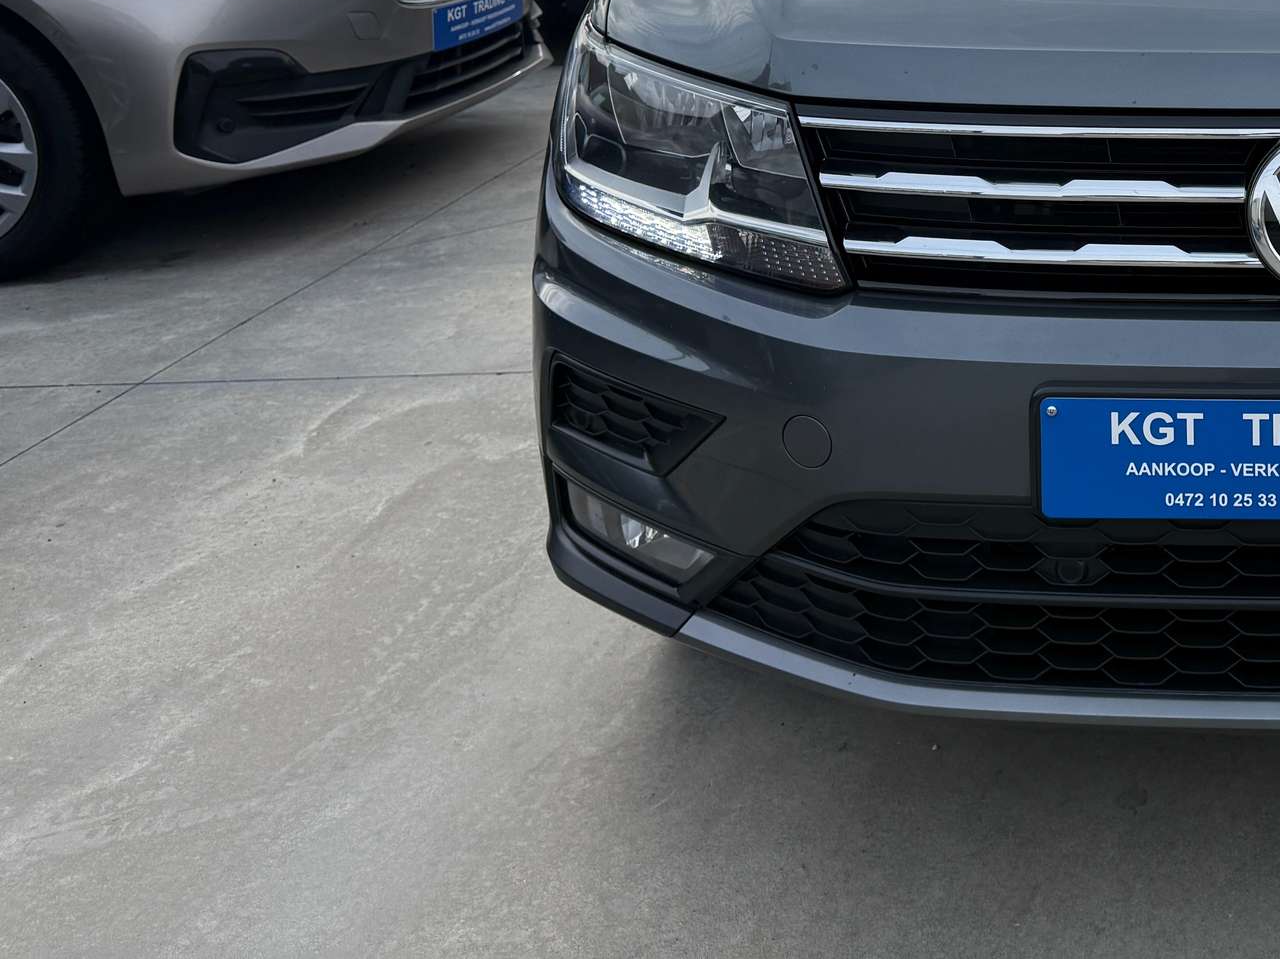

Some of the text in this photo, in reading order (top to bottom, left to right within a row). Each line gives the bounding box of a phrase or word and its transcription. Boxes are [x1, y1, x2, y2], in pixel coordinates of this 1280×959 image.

[448, 5, 467, 22] KGT
[1110, 411, 1204, 446] KGT
[1125, 462, 1216, 477] AANKOOP
[1165, 492, 1204, 507] 0472
[1209, 492, 1228, 507] 10
[1233, 493, 1253, 507] 25
[1257, 493, 1277, 507] 33
